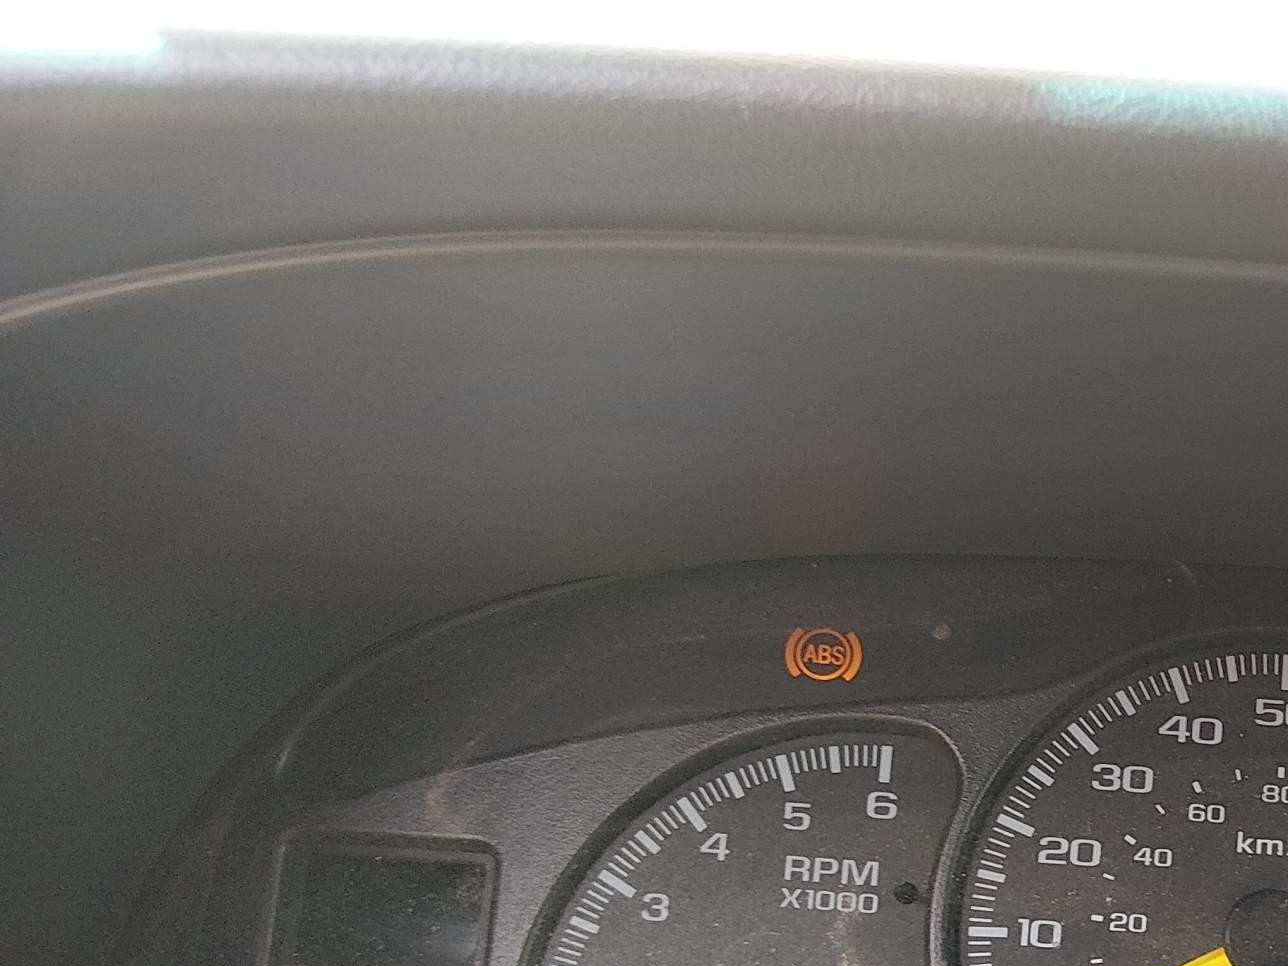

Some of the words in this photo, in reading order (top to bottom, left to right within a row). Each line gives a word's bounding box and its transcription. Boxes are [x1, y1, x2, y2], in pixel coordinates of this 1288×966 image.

[802, 644, 844, 666] ABS
[1159, 717, 1223, 745] 40
[1091, 765, 1153, 793] 30
[783, 803, 811, 830] 5
[865, 792, 897, 819] 6
[1188, 804, 1225, 823] 60
[700, 834, 730, 860] 4
[1037, 838, 1100, 866] 20
[1134, 848, 1172, 867] 40
[783, 855, 879, 886] RPM
[642, 894, 669, 920] 3
[780, 888, 878, 913] X1000
[1019, 919, 1061, 946] 10
[1109, 914, 1147, 932] 20
